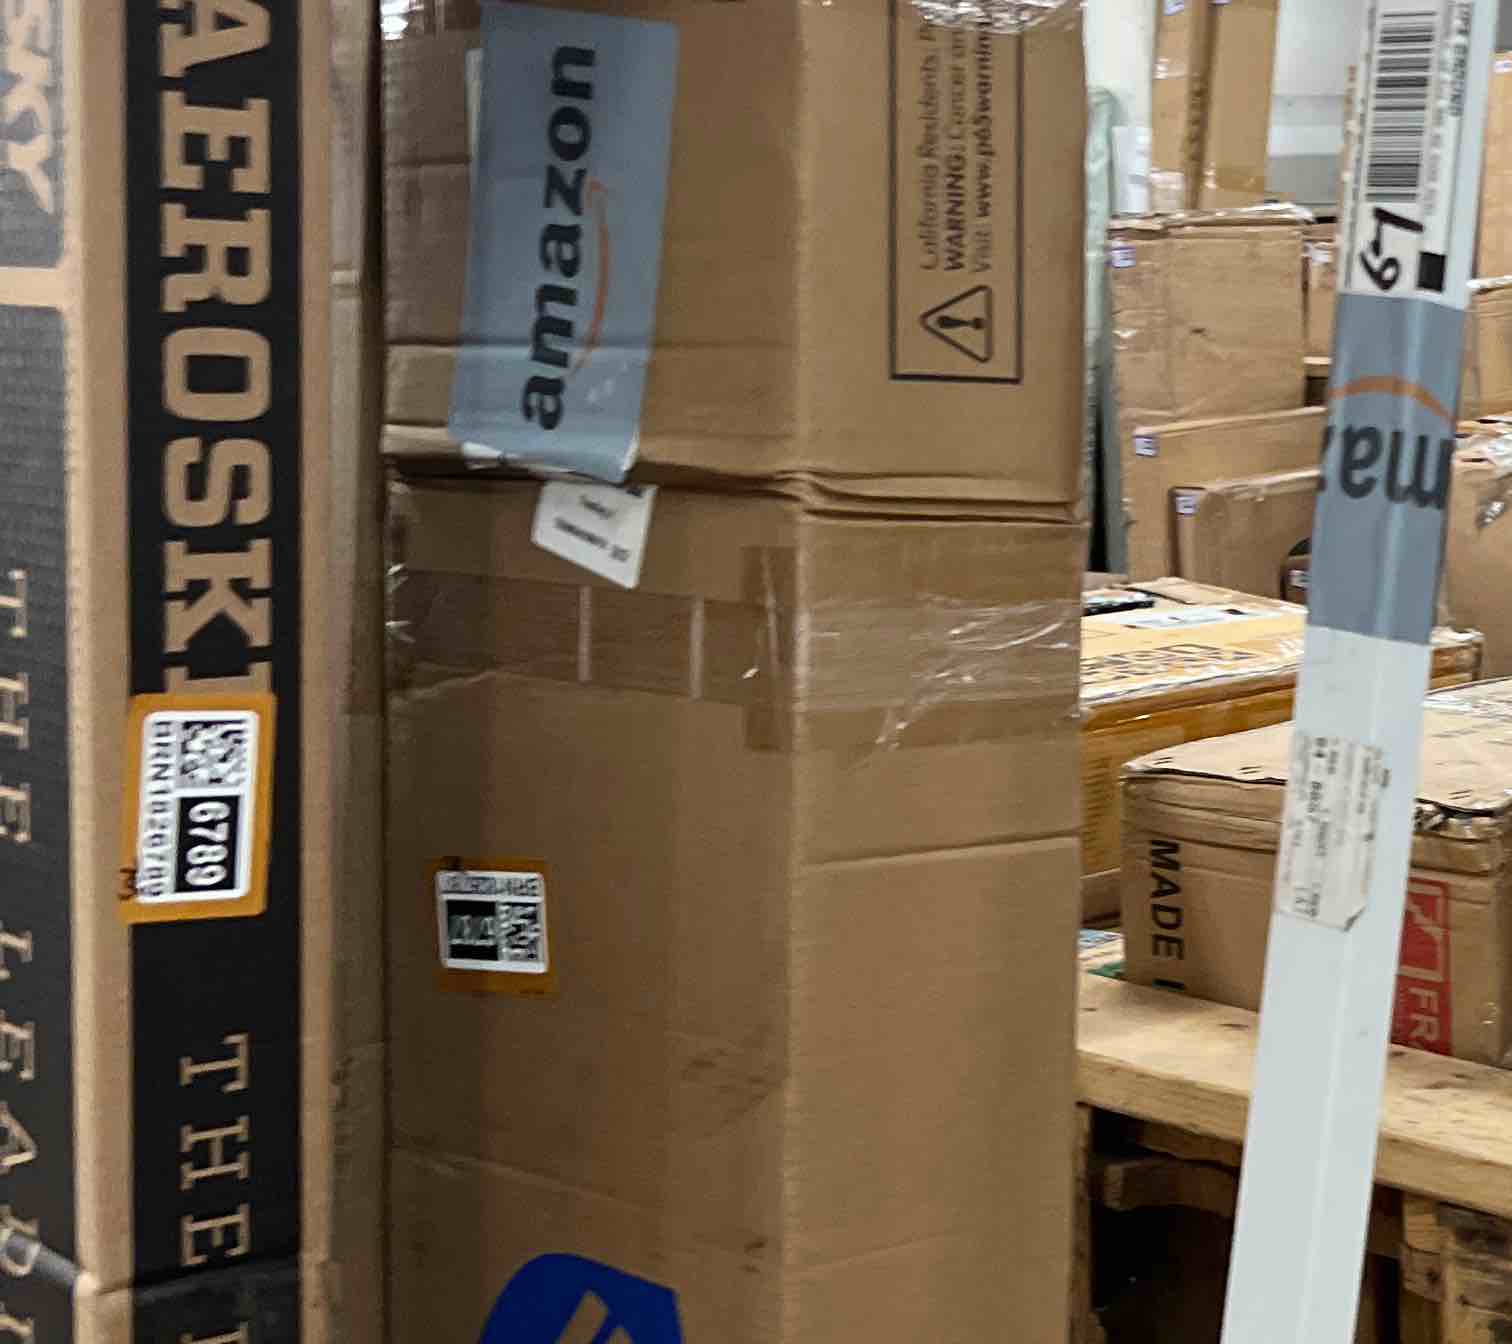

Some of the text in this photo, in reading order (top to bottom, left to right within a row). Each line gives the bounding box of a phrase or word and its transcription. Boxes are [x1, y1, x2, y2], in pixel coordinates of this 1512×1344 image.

[944, 65, 967, 142] Cancer
[520, 44, 597, 431] amazon
[915, 164, 940, 271] California
[944, 144, 967, 273] WARNING:
[185, 799, 232, 888] 6789
[1149, 839, 1186, 961] MADE
[179, 1033, 250, 1266] THE
